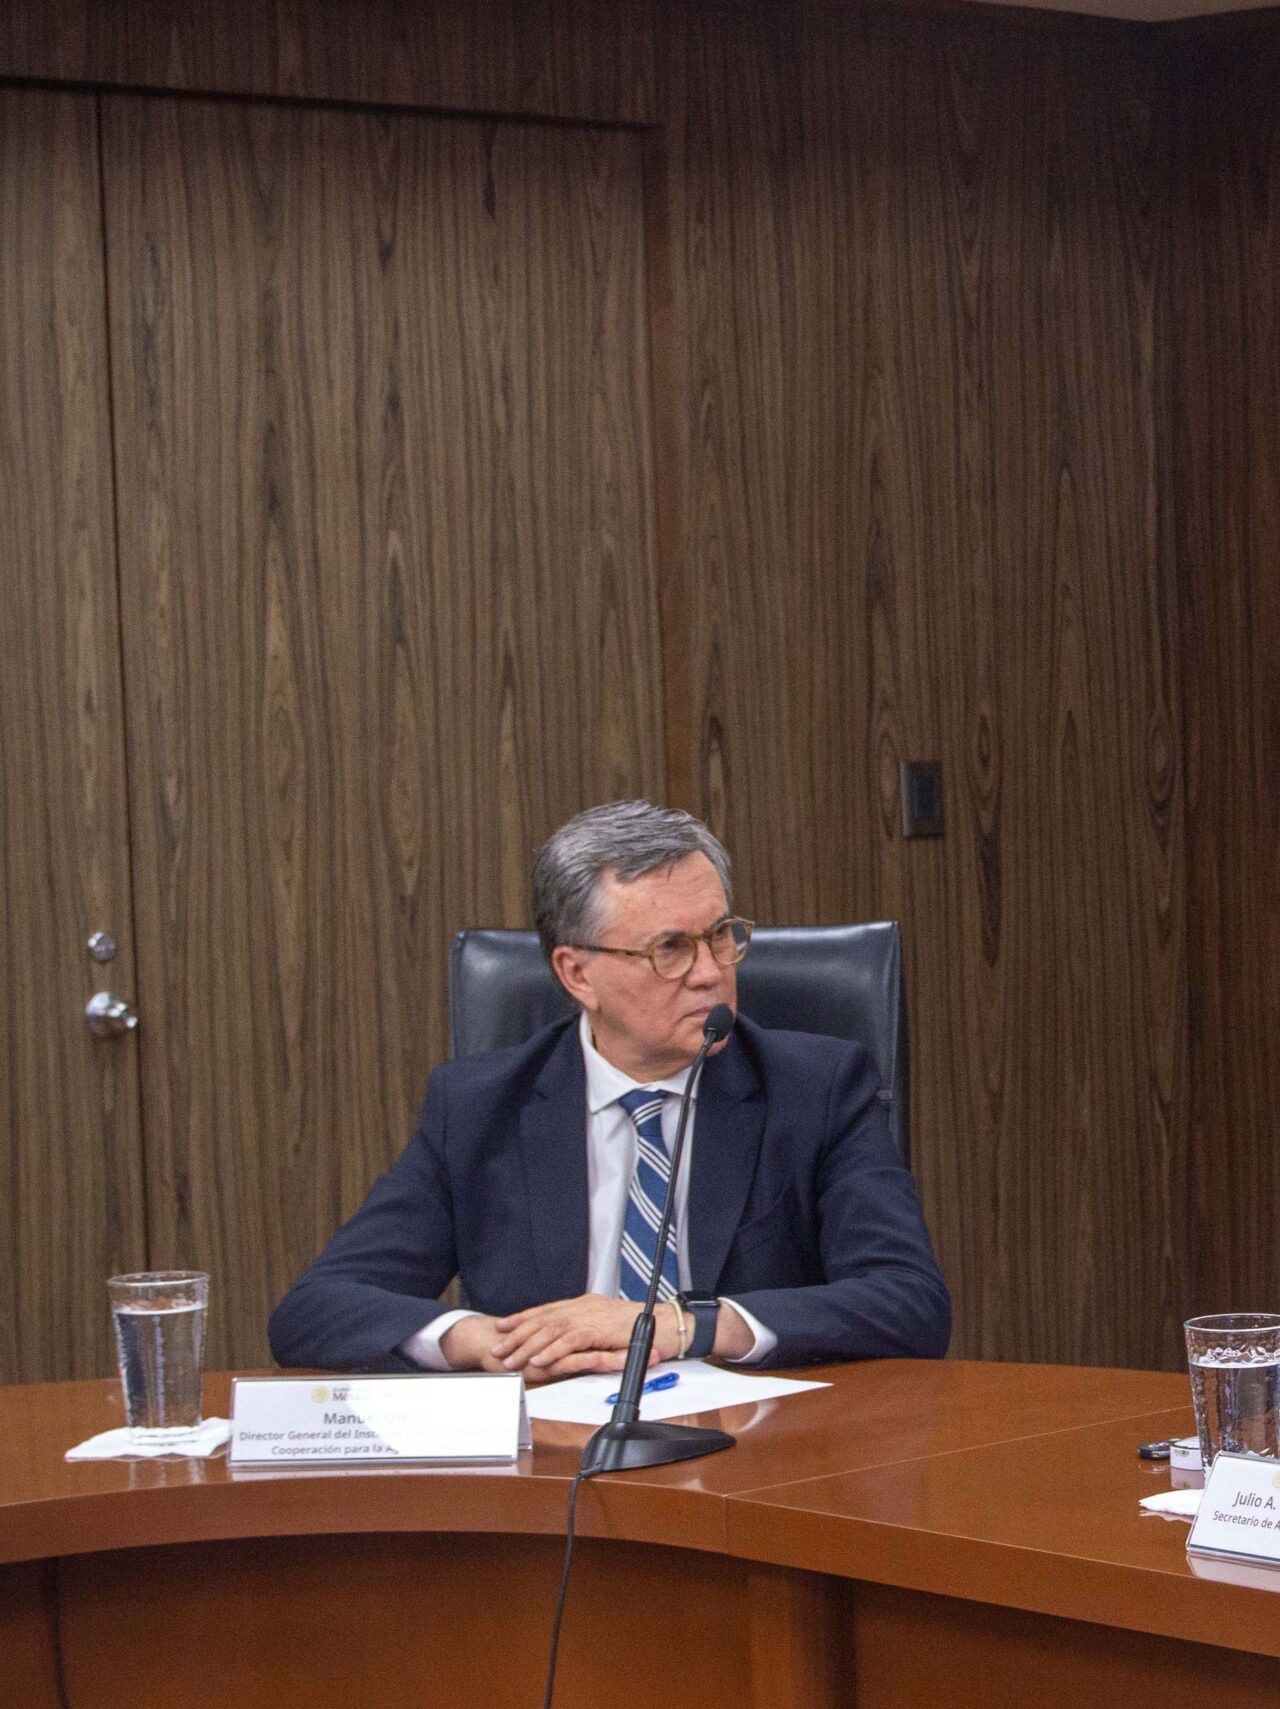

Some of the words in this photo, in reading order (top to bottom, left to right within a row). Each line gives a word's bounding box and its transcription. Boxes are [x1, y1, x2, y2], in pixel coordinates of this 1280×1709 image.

[239, 1431, 286, 1442] Director
[288, 1430, 331, 1441] General
[334, 1429, 352, 1440] del
[271, 1444, 342, 1458] Cooperación
[344, 1445, 370, 1456] para
[373, 1444, 384, 1454] la
[1231, 1491, 1263, 1508] Julio
[1264, 1495, 1276, 1510] A.
[1212, 1510, 1259, 1527] Secretario
[1260, 1517, 1273, 1529] de
